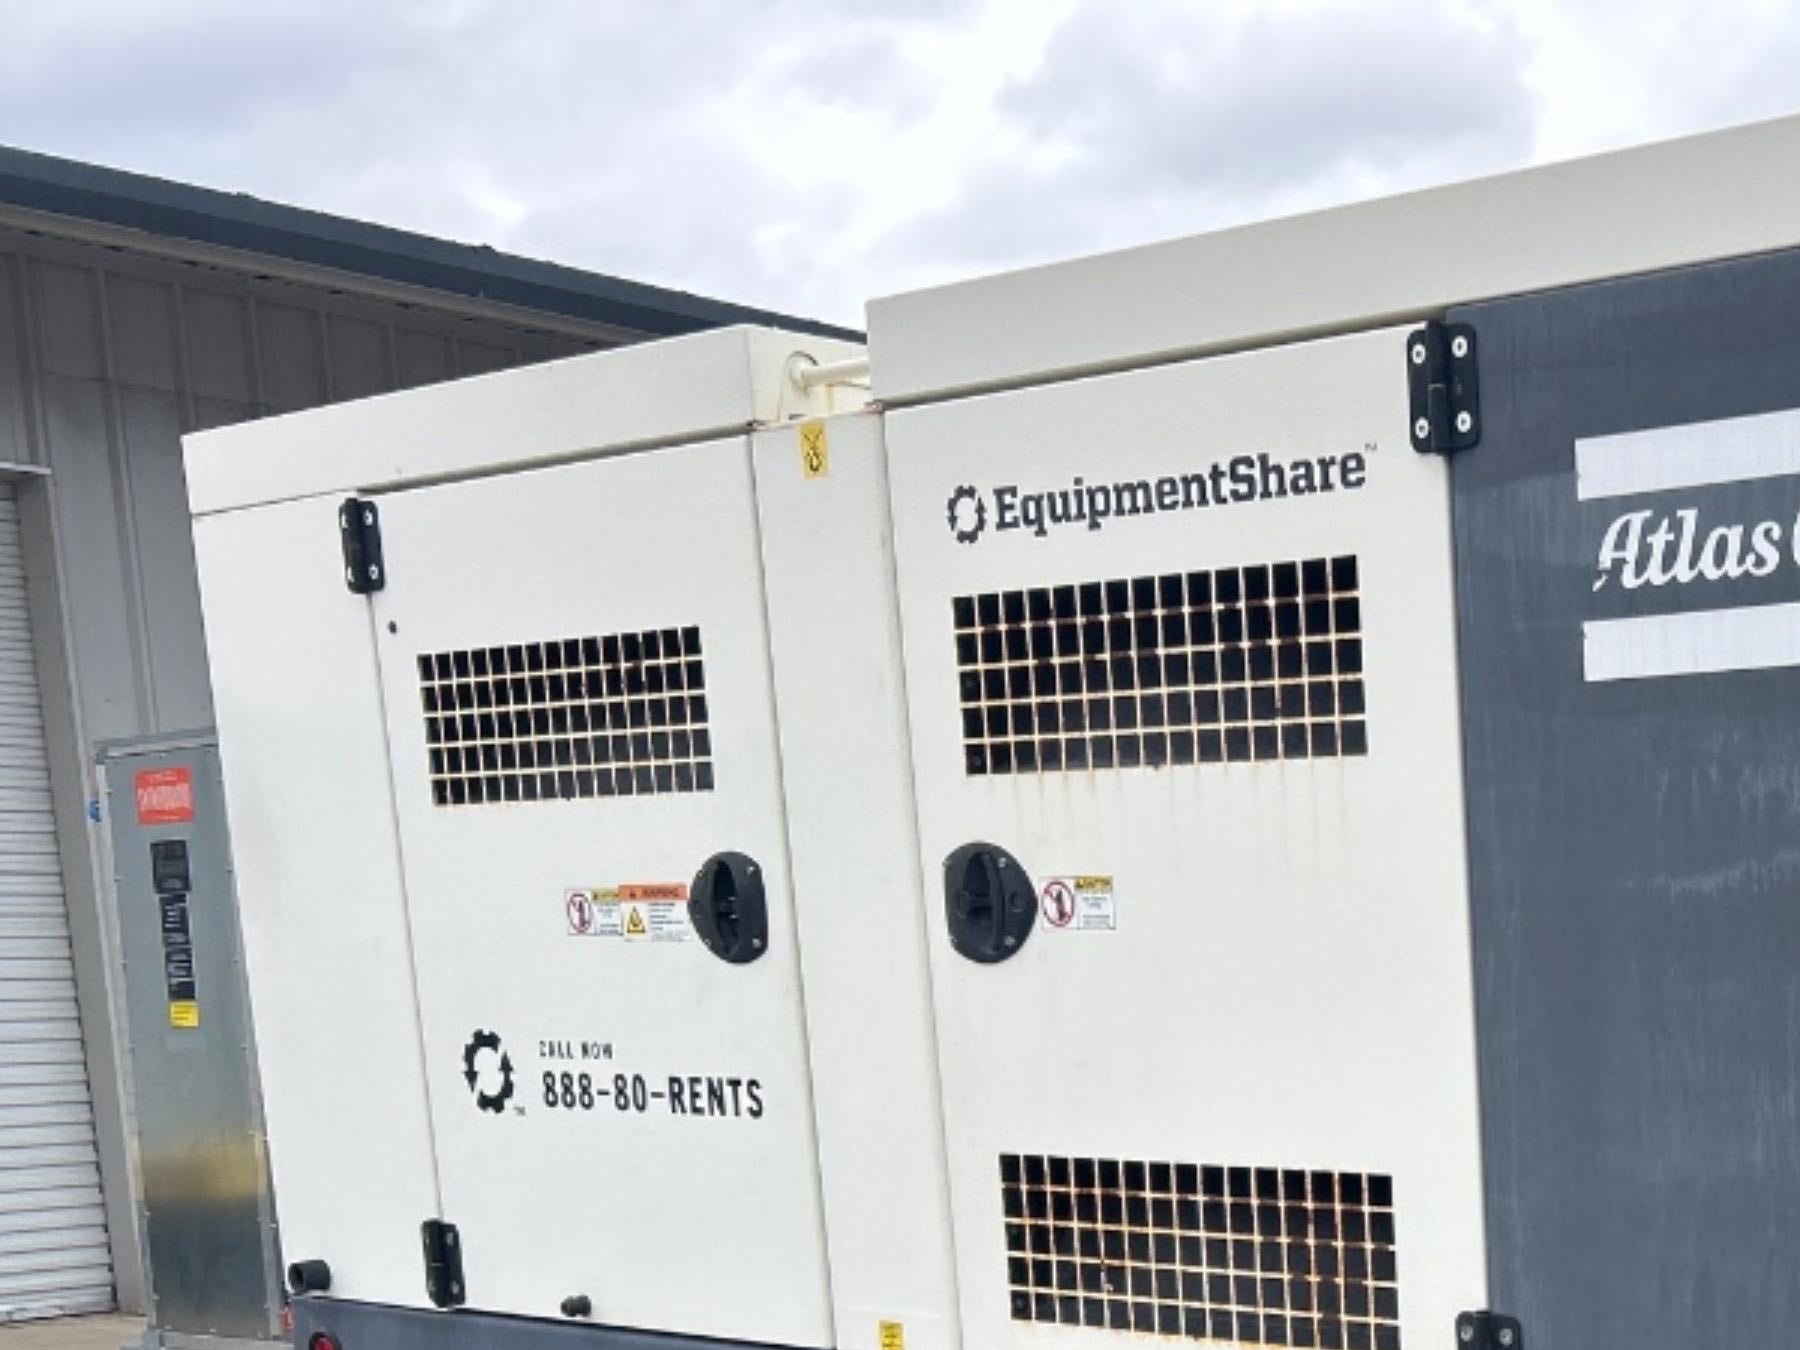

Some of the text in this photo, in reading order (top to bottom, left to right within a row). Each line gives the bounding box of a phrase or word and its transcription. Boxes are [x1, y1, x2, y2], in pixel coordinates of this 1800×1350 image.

[993, 451, 1366, 537] EquipmentShare
[1593, 507, 1780, 592] Atlas
[539, 1040, 613, 1060] CALL NOW
[542, 1071, 763, 1118] 888-80-RENTS
